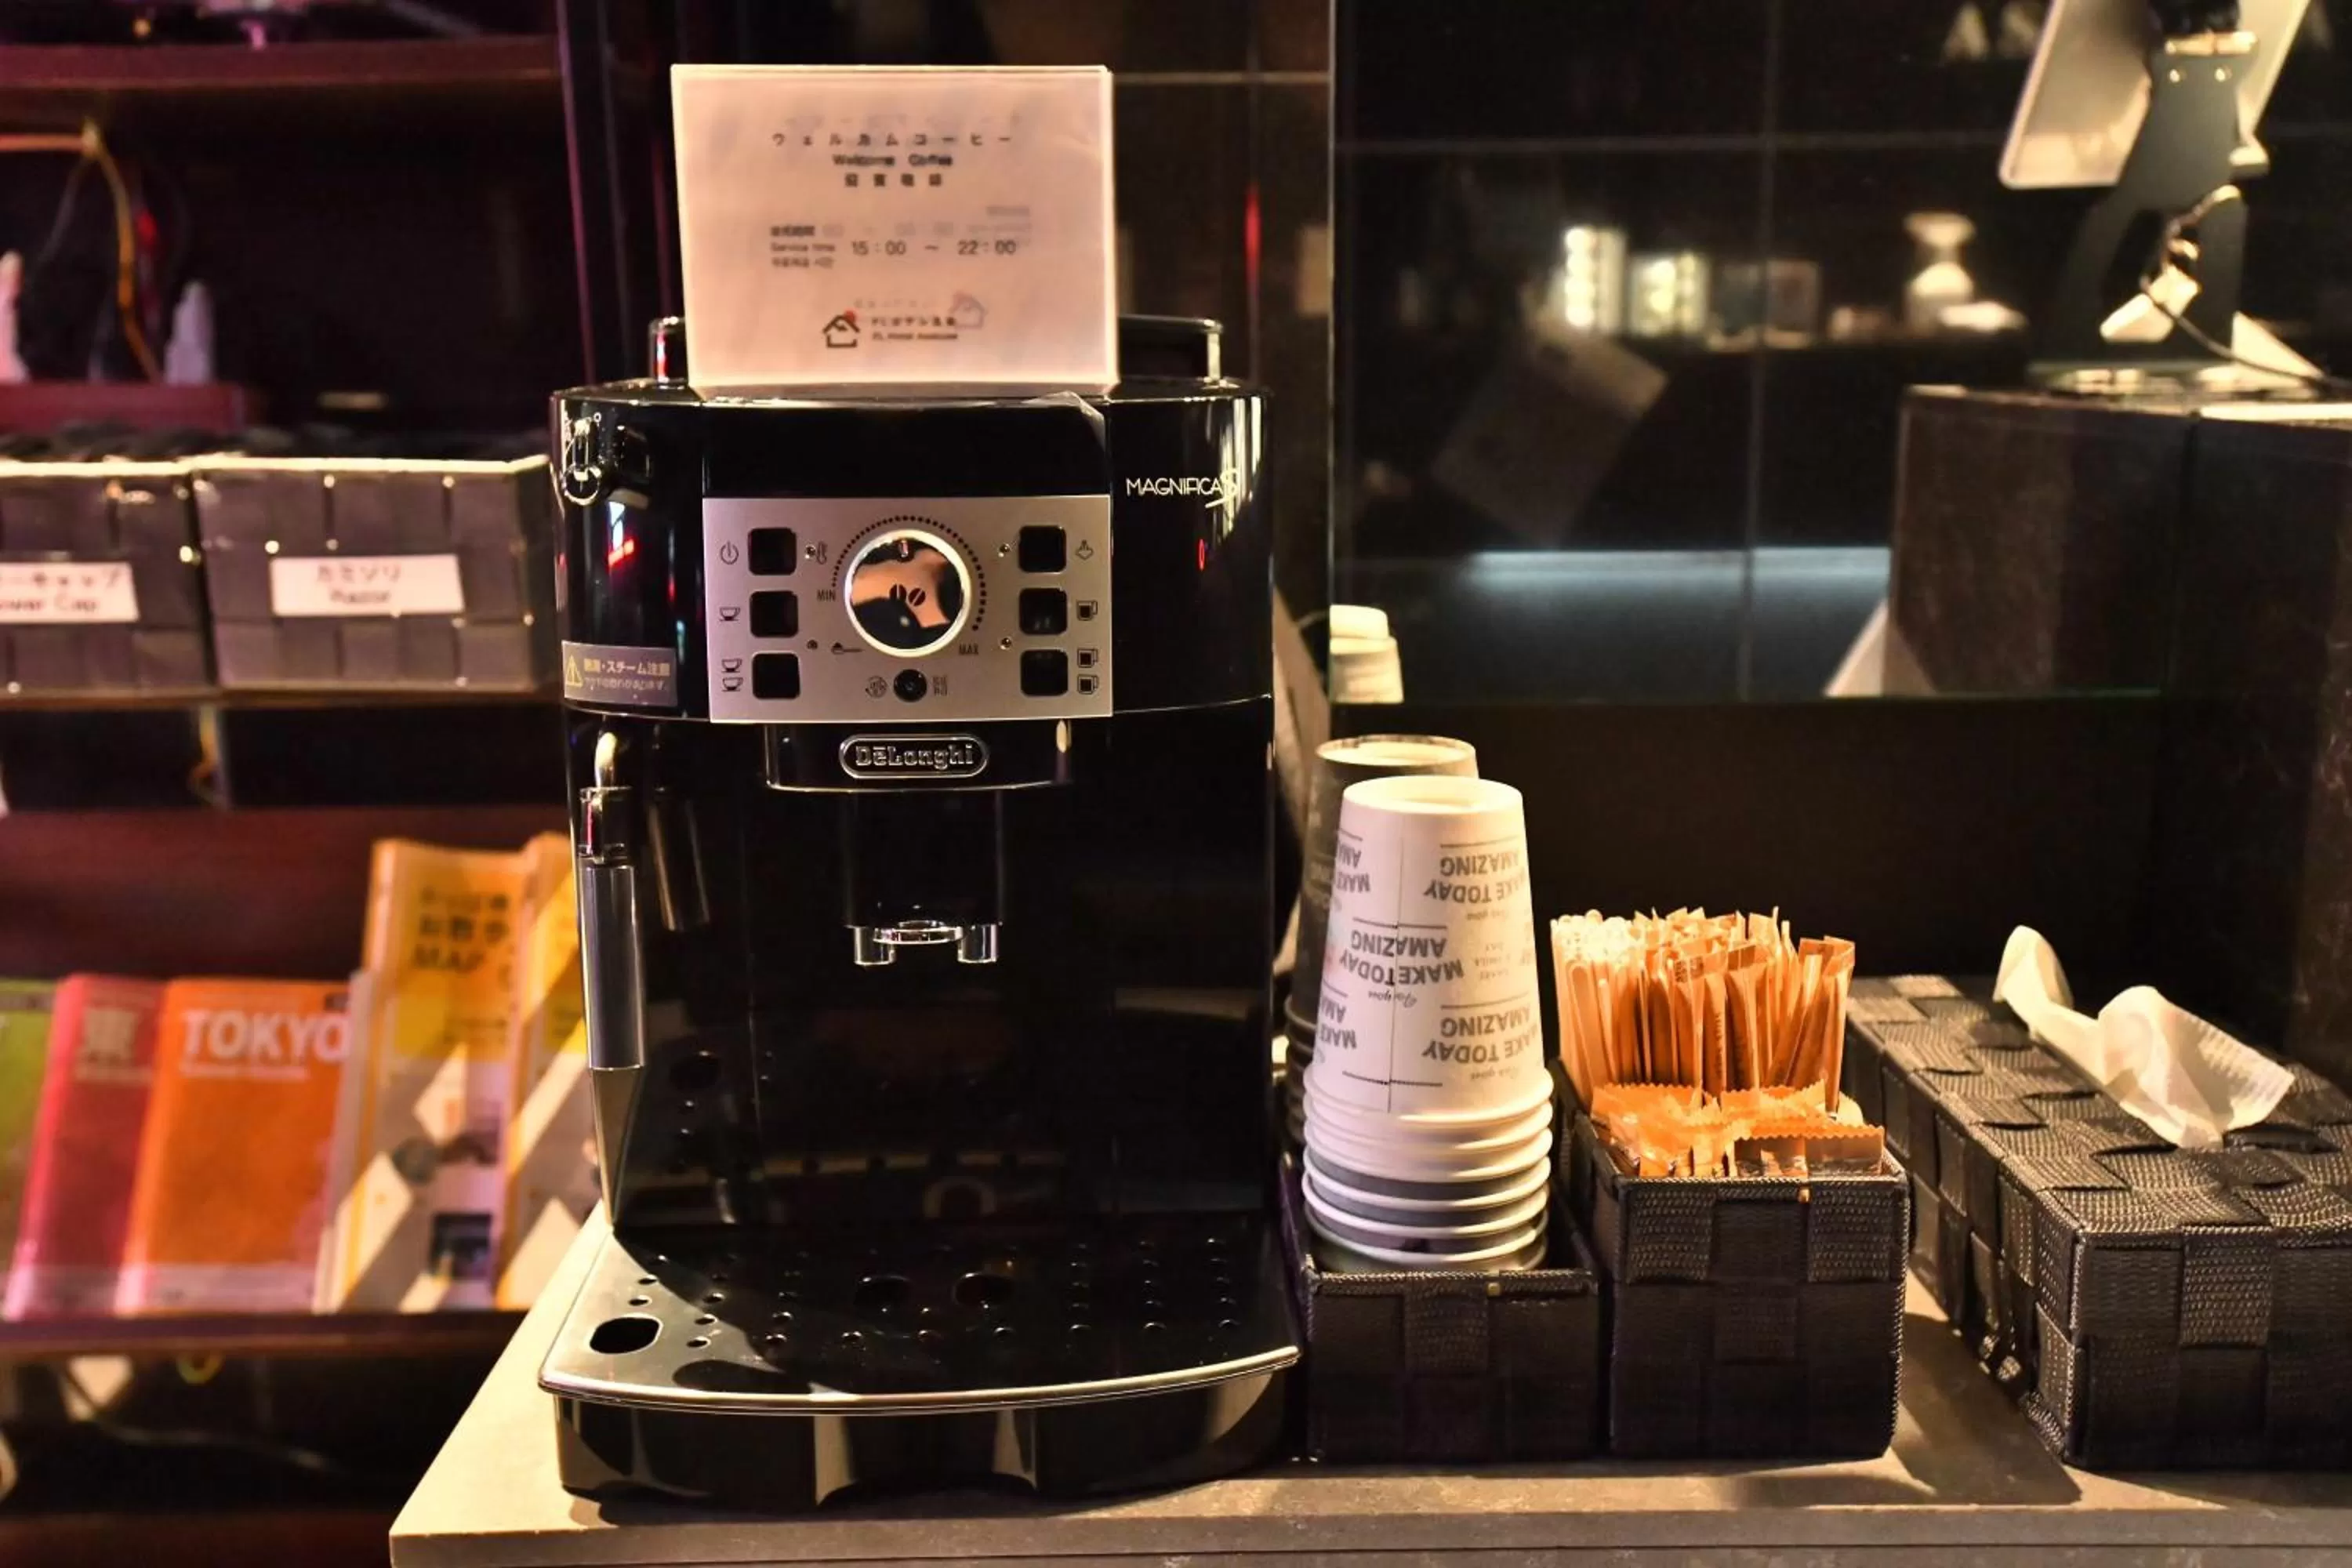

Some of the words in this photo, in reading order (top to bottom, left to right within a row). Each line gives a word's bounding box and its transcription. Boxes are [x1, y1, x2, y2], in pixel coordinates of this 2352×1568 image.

[909, 154, 953, 167] Coffee
[1125, 477, 1225, 496] MAGNIFICA
[816, 590, 837, 601] MIN
[959, 644, 979, 655] MAX
[1423, 879, 1492, 904] TODAY
[1350, 930, 1447, 959] AMAZING
[1339, 948, 1396, 987] TODAY
[1398, 959, 1465, 985] MAKE
[1440, 1005, 1530, 1039] AMAZING
[181, 1009, 353, 1063] TOKYO
[1421, 1039, 1500, 1064] TODAY
